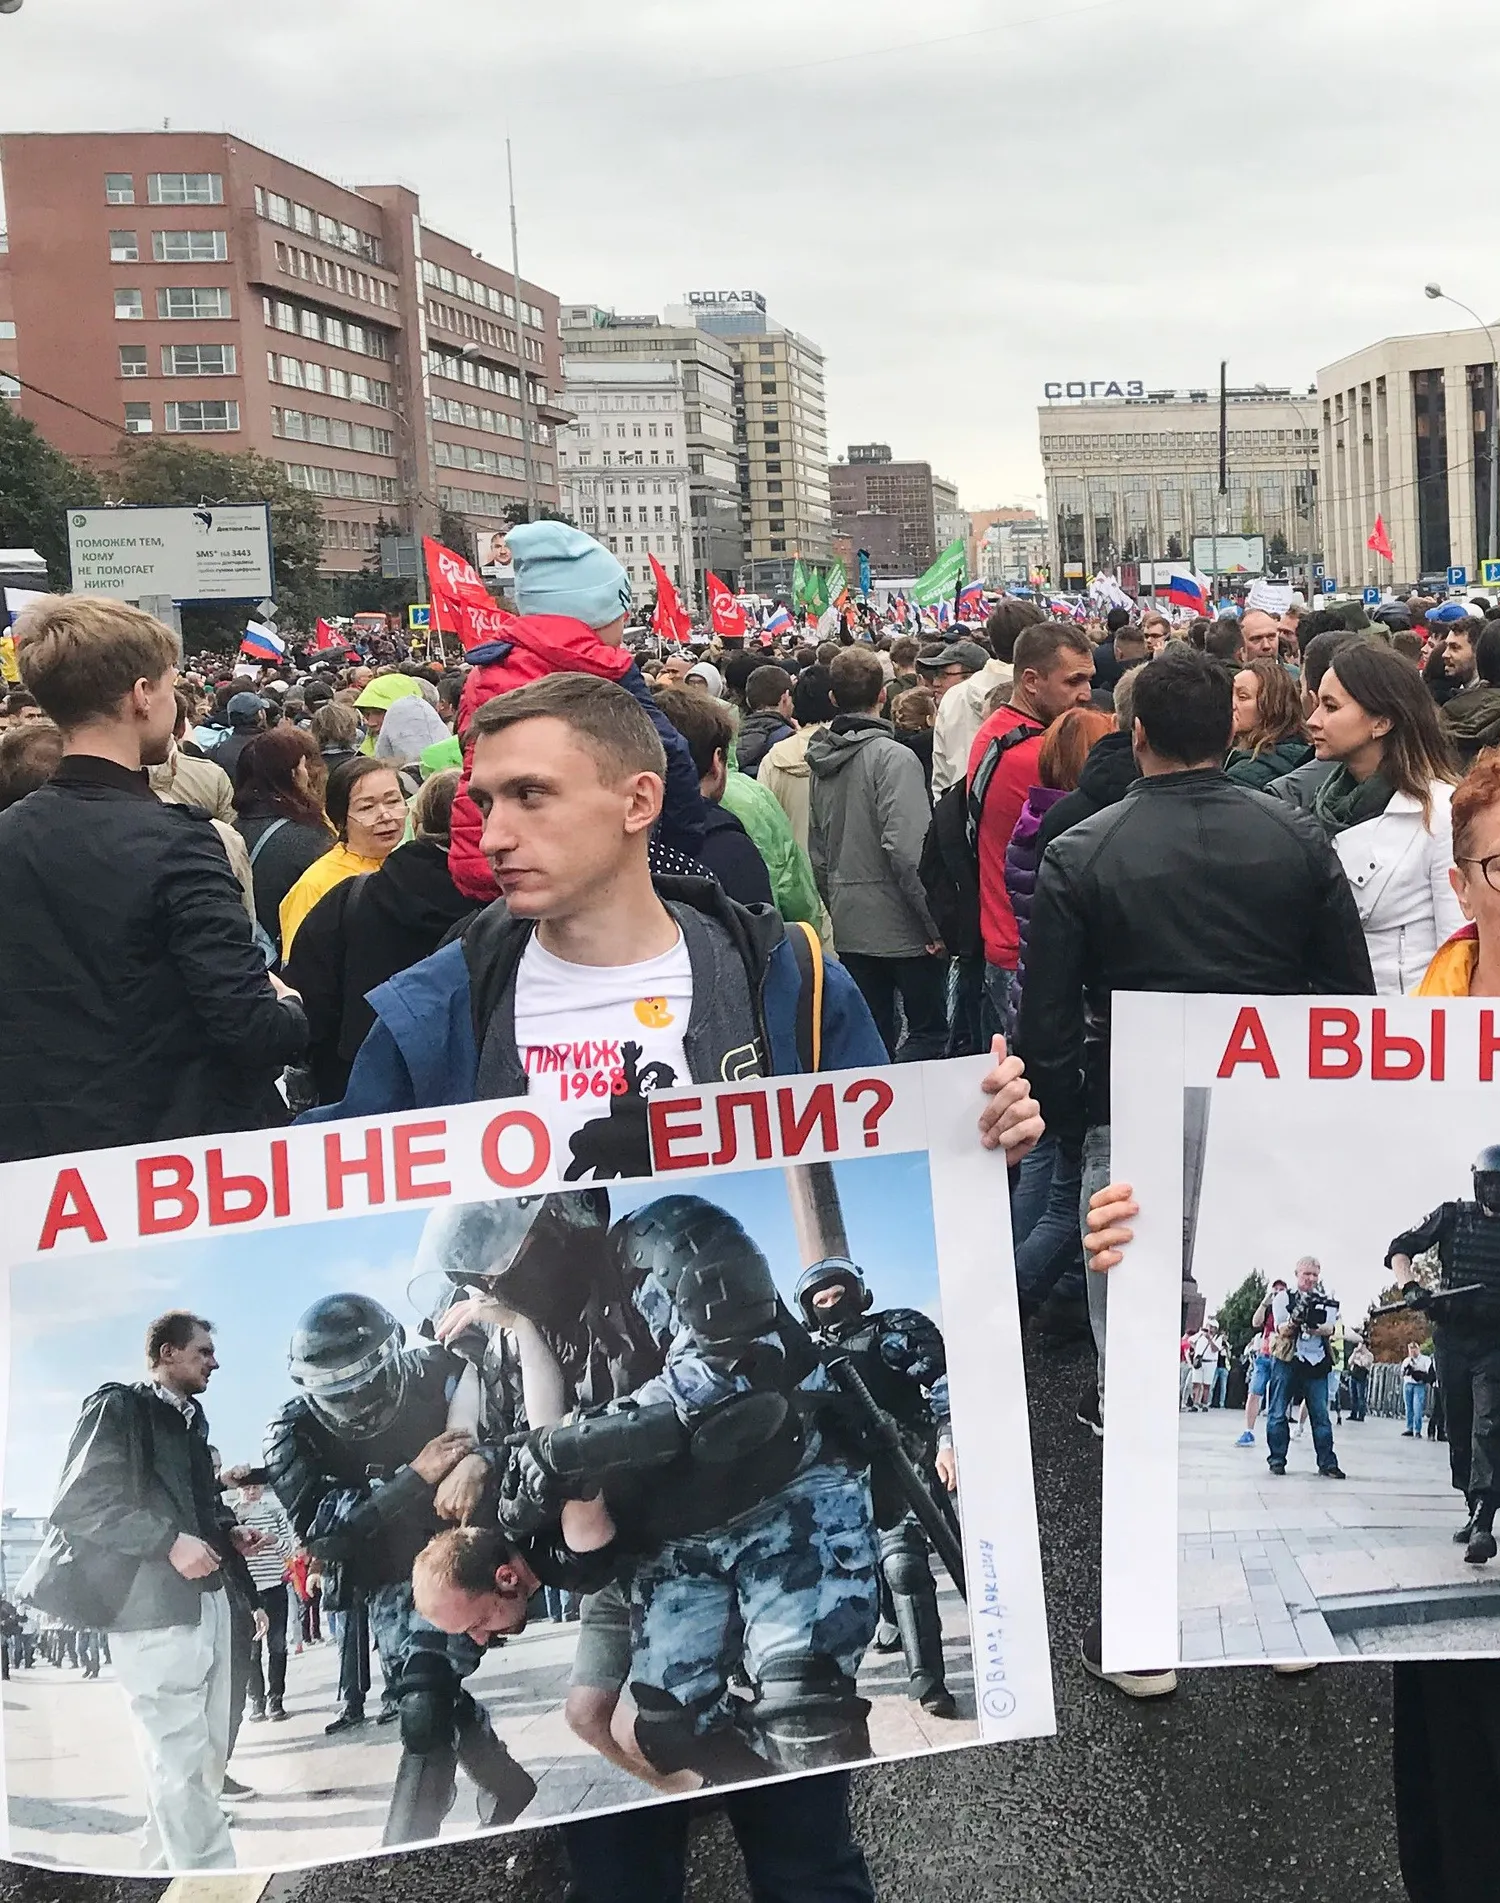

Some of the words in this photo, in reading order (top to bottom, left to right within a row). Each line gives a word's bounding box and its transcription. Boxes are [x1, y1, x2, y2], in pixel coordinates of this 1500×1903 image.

[689, 291, 752, 302] СОГАЗ
[1045, 381, 1144, 398] СОГАЗ
[76, 538, 137, 548] ПОМОЖЕМ
[139, 537, 164, 547] ТЕМ,
[82, 552, 114, 561] КОМУ
[232, 549, 251, 557] 3443
[78, 566, 92, 575] НЕ
[97, 565, 154, 575] ПОМОГАЕТ
[84, 579, 124, 588] НИКТО!
[1217, 1006, 1280, 1079] А
[1308, 1007, 1446, 1081] ВЫ
[525, 1040, 620, 1074] ПАРИЖ
[560, 1068, 629, 1101] 1968
[39, 1168, 107, 1250] А
[137, 1140, 291, 1235] ВЫ
[325, 1120, 451, 1209] НЕ
